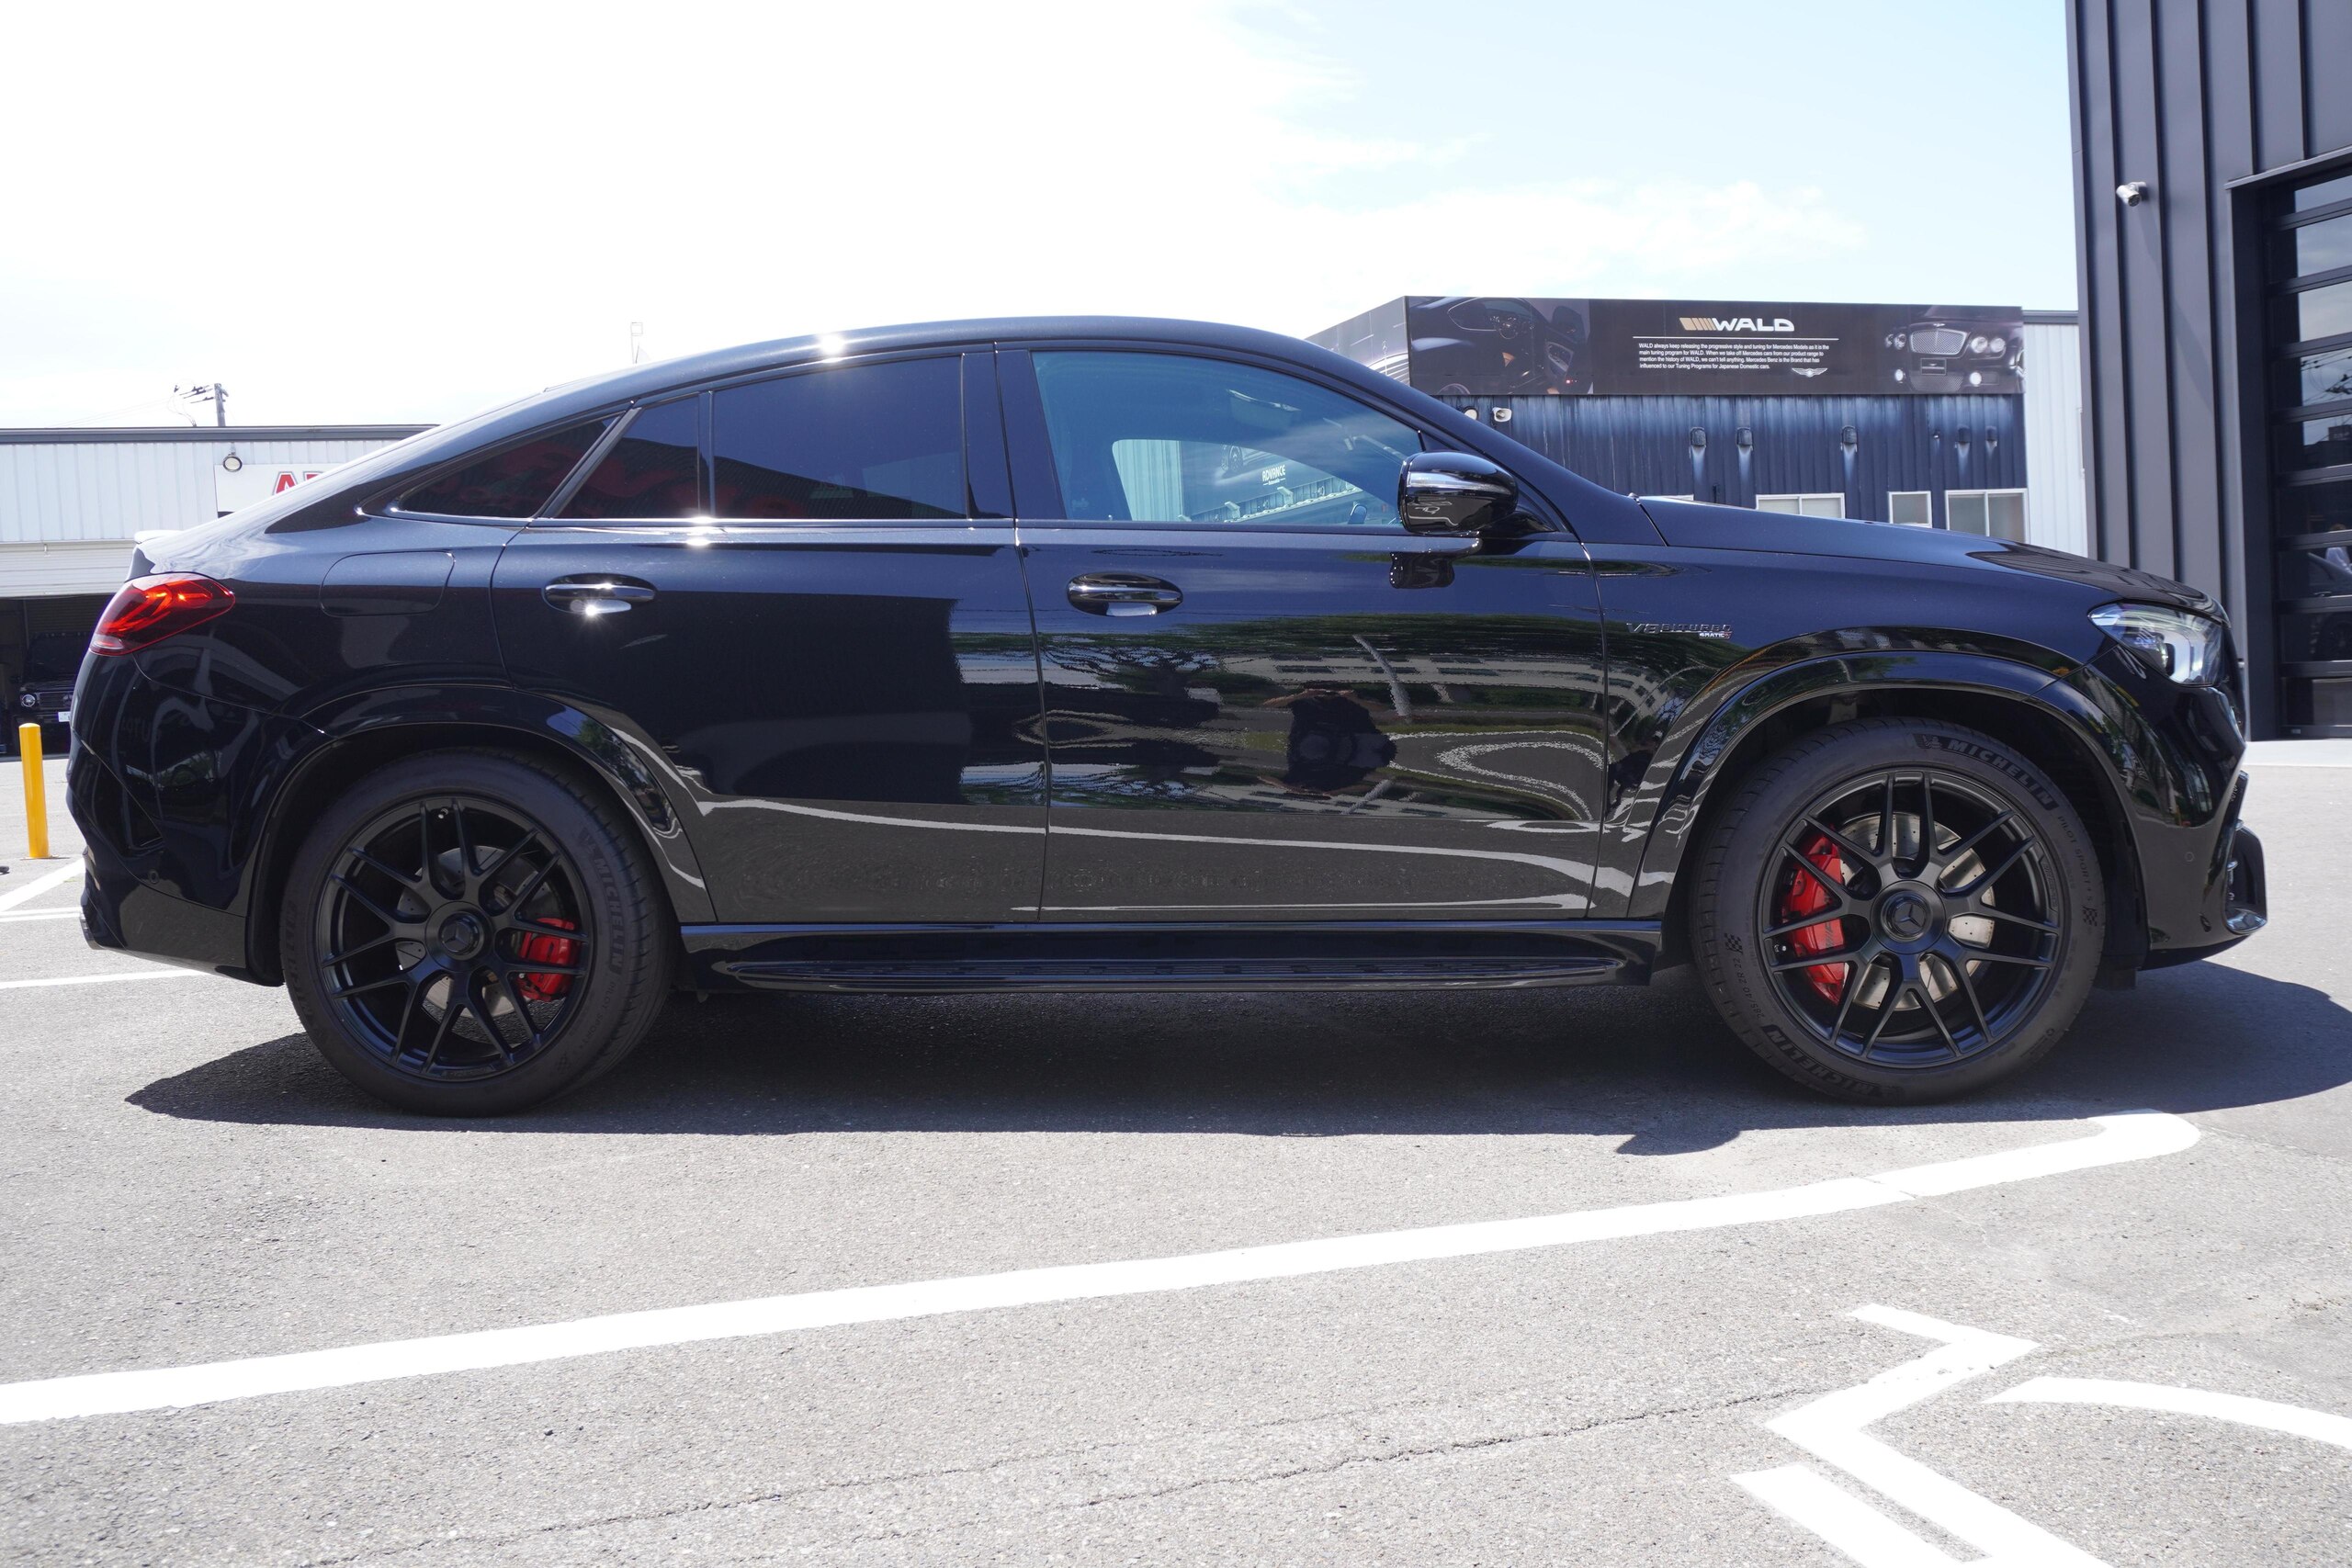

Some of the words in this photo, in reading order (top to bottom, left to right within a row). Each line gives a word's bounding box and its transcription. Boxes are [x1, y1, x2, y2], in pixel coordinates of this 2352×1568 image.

[1712, 317, 1795, 332] WALD
[1626, 623, 1659, 634] V8
[1660, 624, 1732, 633] BITURBO
[1947, 738, 2055, 807] MICHELIN
[594, 857, 625, 969] MICHELIN
